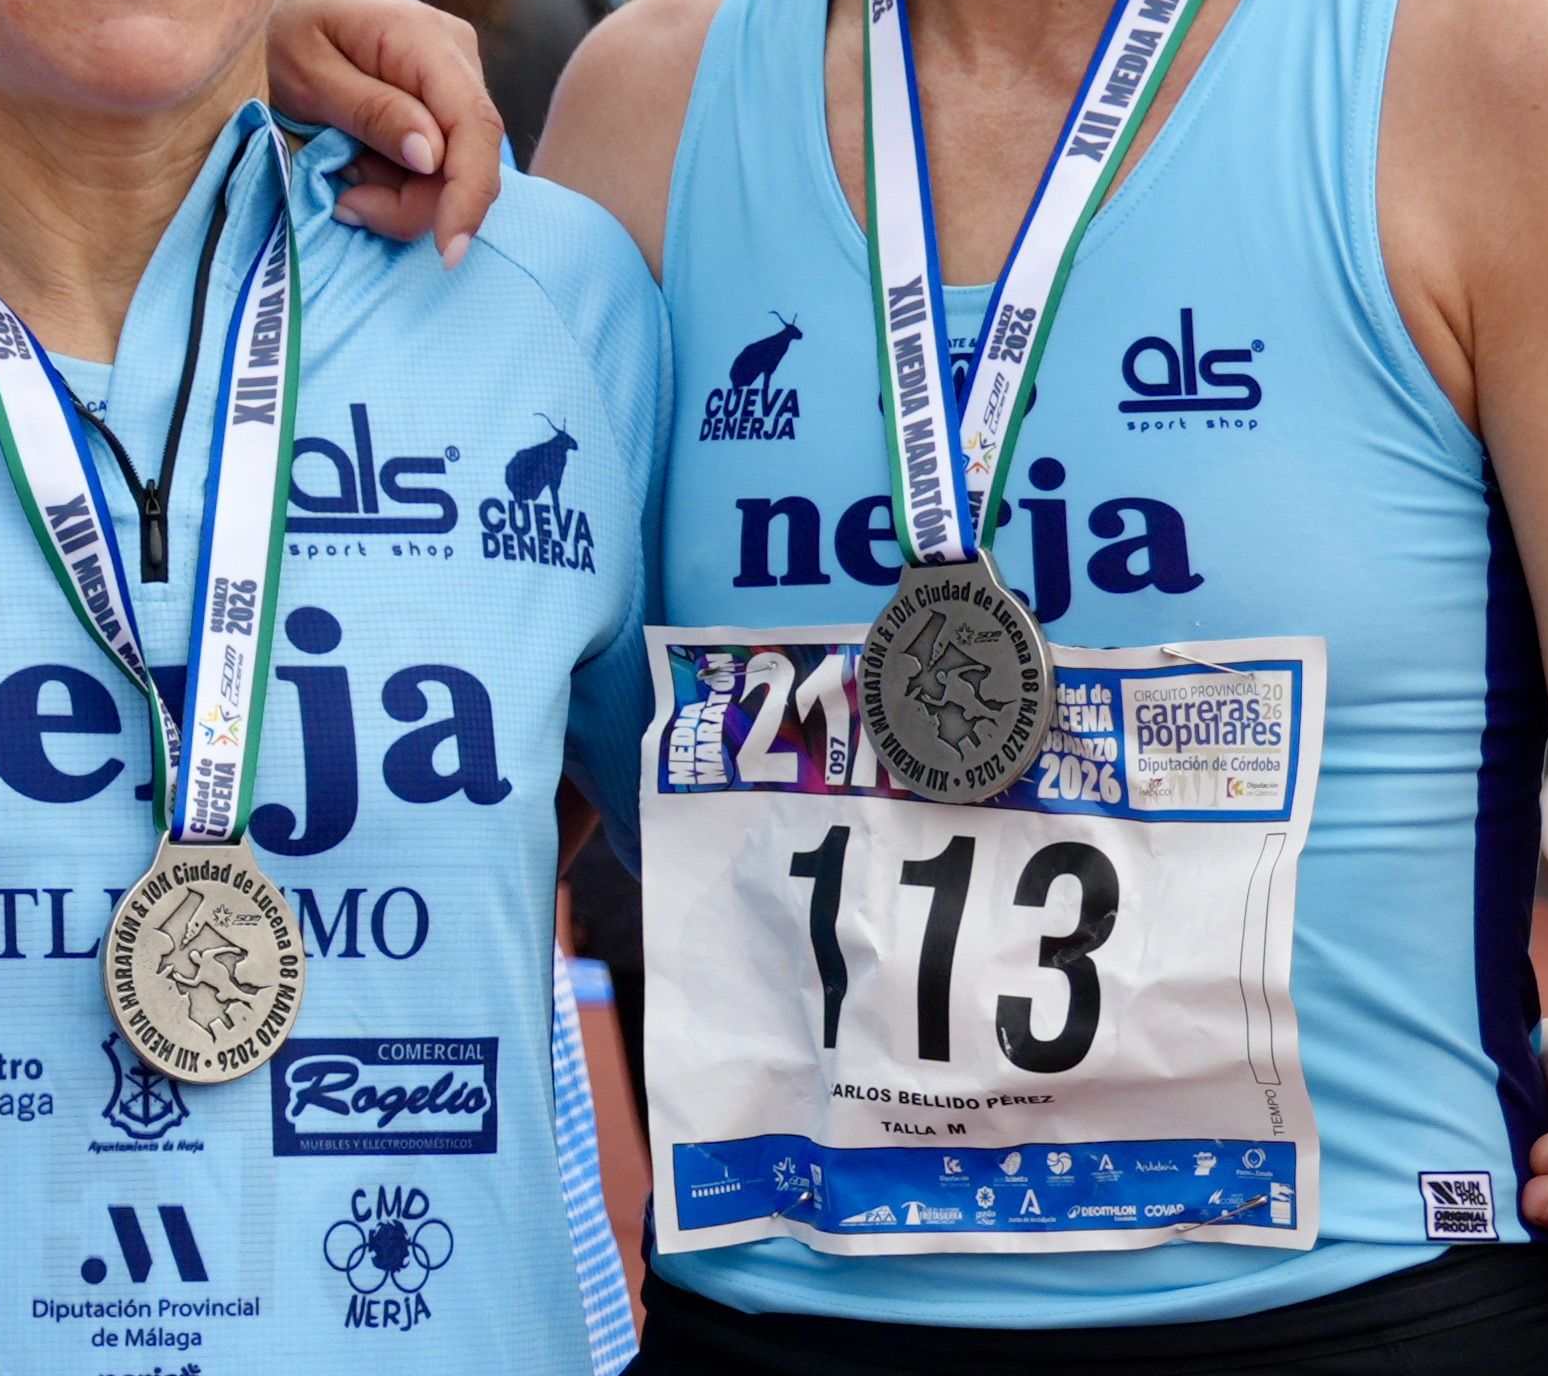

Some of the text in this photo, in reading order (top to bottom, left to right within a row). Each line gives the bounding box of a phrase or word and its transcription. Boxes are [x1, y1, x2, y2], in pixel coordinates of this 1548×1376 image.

[1065, 109, 1123, 163] XII
[1098, 28, 1164, 109] MEDIA
[1000, 306, 1038, 365] 2026
[232, 286, 286, 426] XII MEDIA
[1118, 307, 1263, 414] als
[705, 386, 802, 421] CUEVA
[887, 274, 953, 551] XII MEDIA MARATÓN
[698, 410, 797, 442] DENERJA
[1126, 416, 1259, 434] sport shop
[478, 496, 595, 549] CUEVA
[288, 538, 455, 561] sport shop
[481, 530, 597, 575] DENERJA
[45, 493, 117, 643] XII MEDIA
[226, 578, 258, 637] 2026
[863, 579, 1033, 736] MARATÓN Ciudad de Lucena
[1090, 684, 1113, 705] de
[1134, 683, 1261, 703] CIRCUITO PROVINCIAL
[1135, 696, 1261, 725] carreras
[1261, 683, 1283, 702] 20
[695, 652, 736, 785] MARATÓN
[1260, 702, 1283, 721] 26
[668, 700, 706, 785] MEDIA
[1137, 712, 1282, 754] populares
[829, 736, 846, 775] 097
[1137, 756, 1281, 775] Diputación de Córdoba
[1036, 752, 1122, 805] 2026
[189, 776, 211, 834] Ciudad
[205, 761, 237, 838] LUCENA
[114, 859, 233, 1012] MARATÓN Ciudad
[788, 824, 1121, 1075] 113
[377, 1041, 485, 1062] COMERCIAL
[292, 1062, 488, 1128] Rogelio
[898, 1090, 1056, 1111] BELLIDO PÉREZ
[1267, 1088, 1285, 1136] TIEMPO
[299, 1138, 350, 1152] MUEBLES
[362, 1136, 474, 1152] ELECTRODOMÉSTICOS
[880, 1120, 967, 1136] TALLA M
[349, 1186, 430, 1222] CMD
[1454, 1180, 1480, 1195] RUN
[1080, 1204, 1138, 1218] DECATHLON
[1143, 1203, 1186, 1218] COVAP
[1434, 1210, 1488, 1223] ORIGINAL
[1434, 1223, 1488, 1233] PRODUCT
[32, 1296, 261, 1323] Diputación Provincial
[90, 1326, 203, 1352] de Málaga
